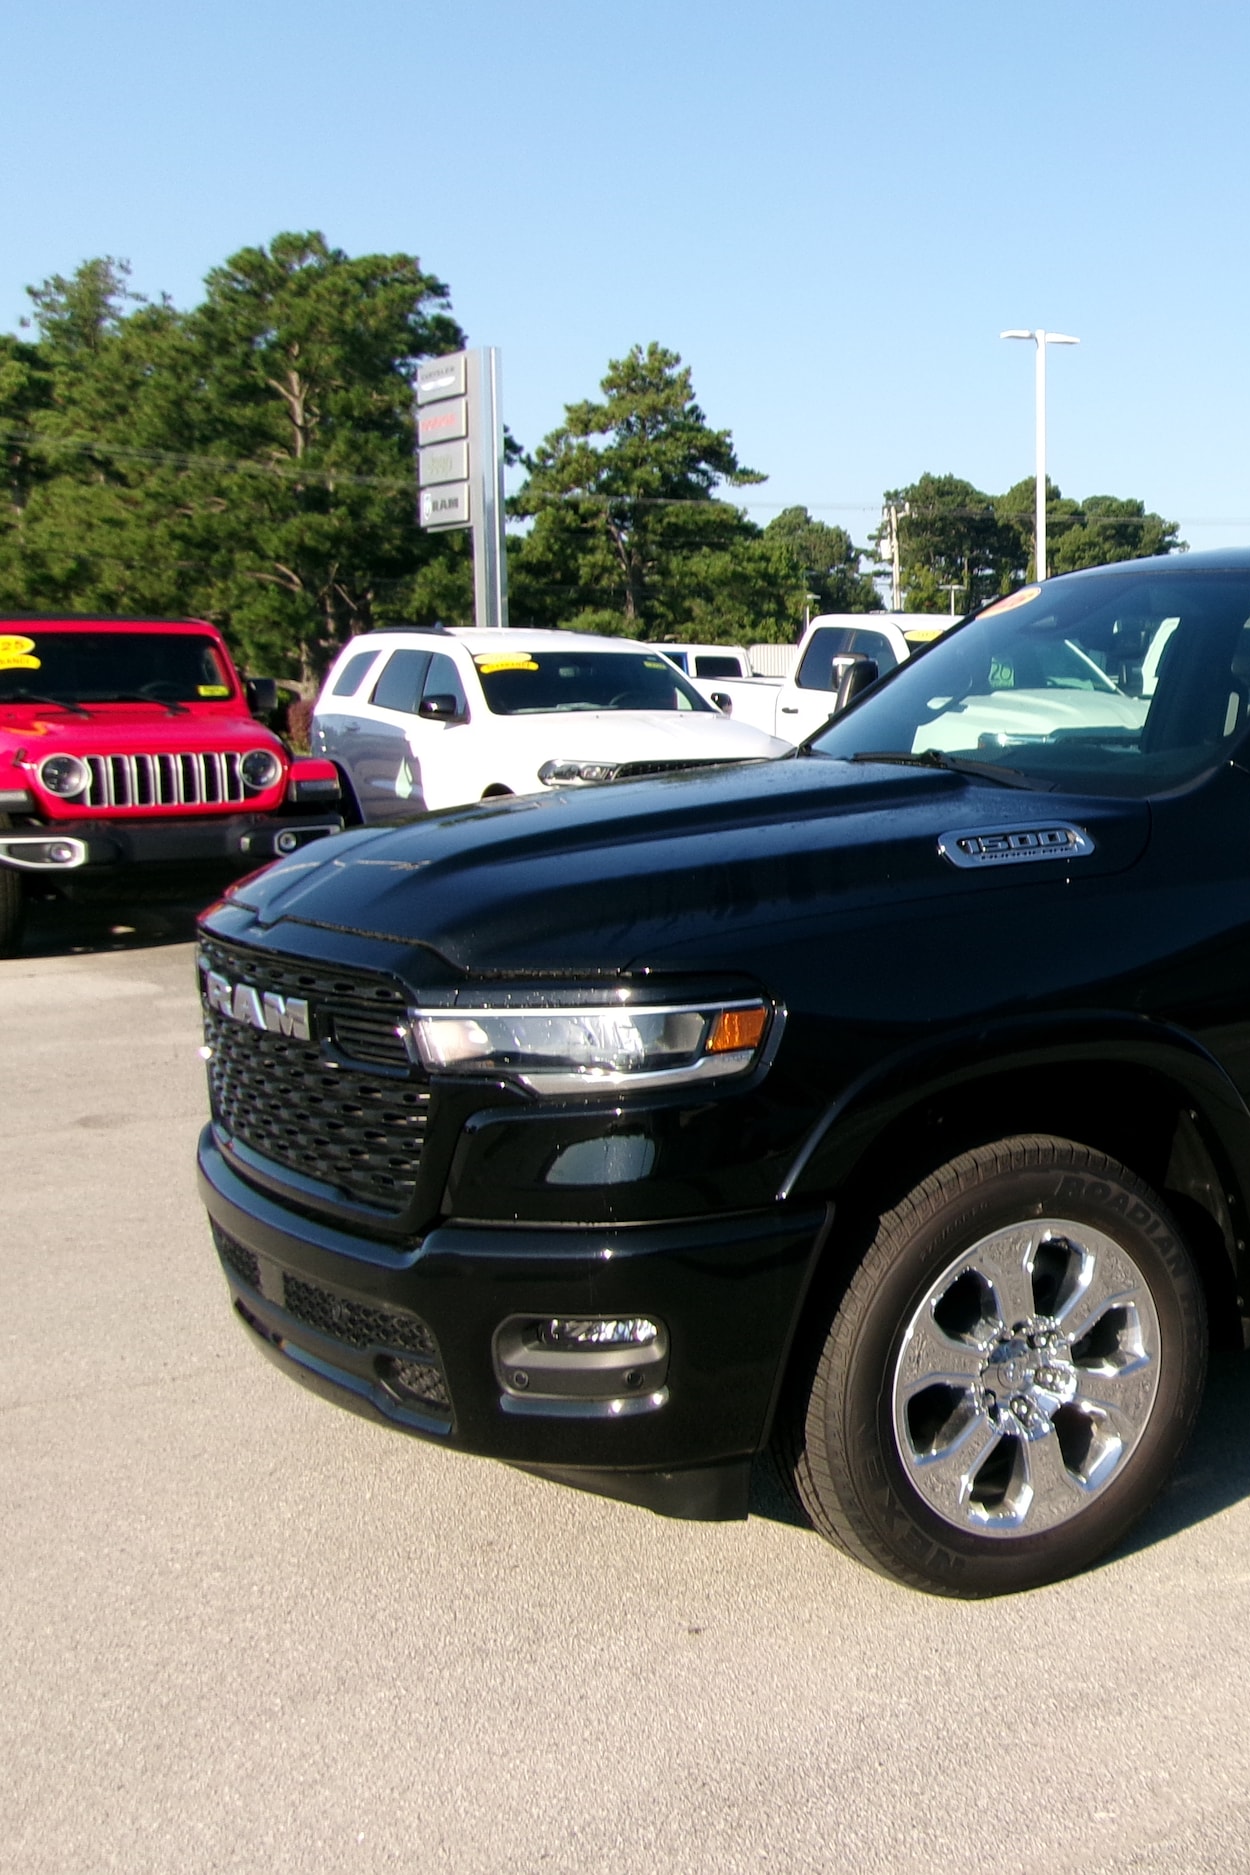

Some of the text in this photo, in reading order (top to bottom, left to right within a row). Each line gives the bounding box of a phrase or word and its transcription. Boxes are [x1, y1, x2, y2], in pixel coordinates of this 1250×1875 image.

[431, 497, 459, 512] RAM
[967, 830, 1068, 855] 1500
[206, 970, 310, 1041] RAM
[1054, 1173, 1190, 1278] ROADIAN
